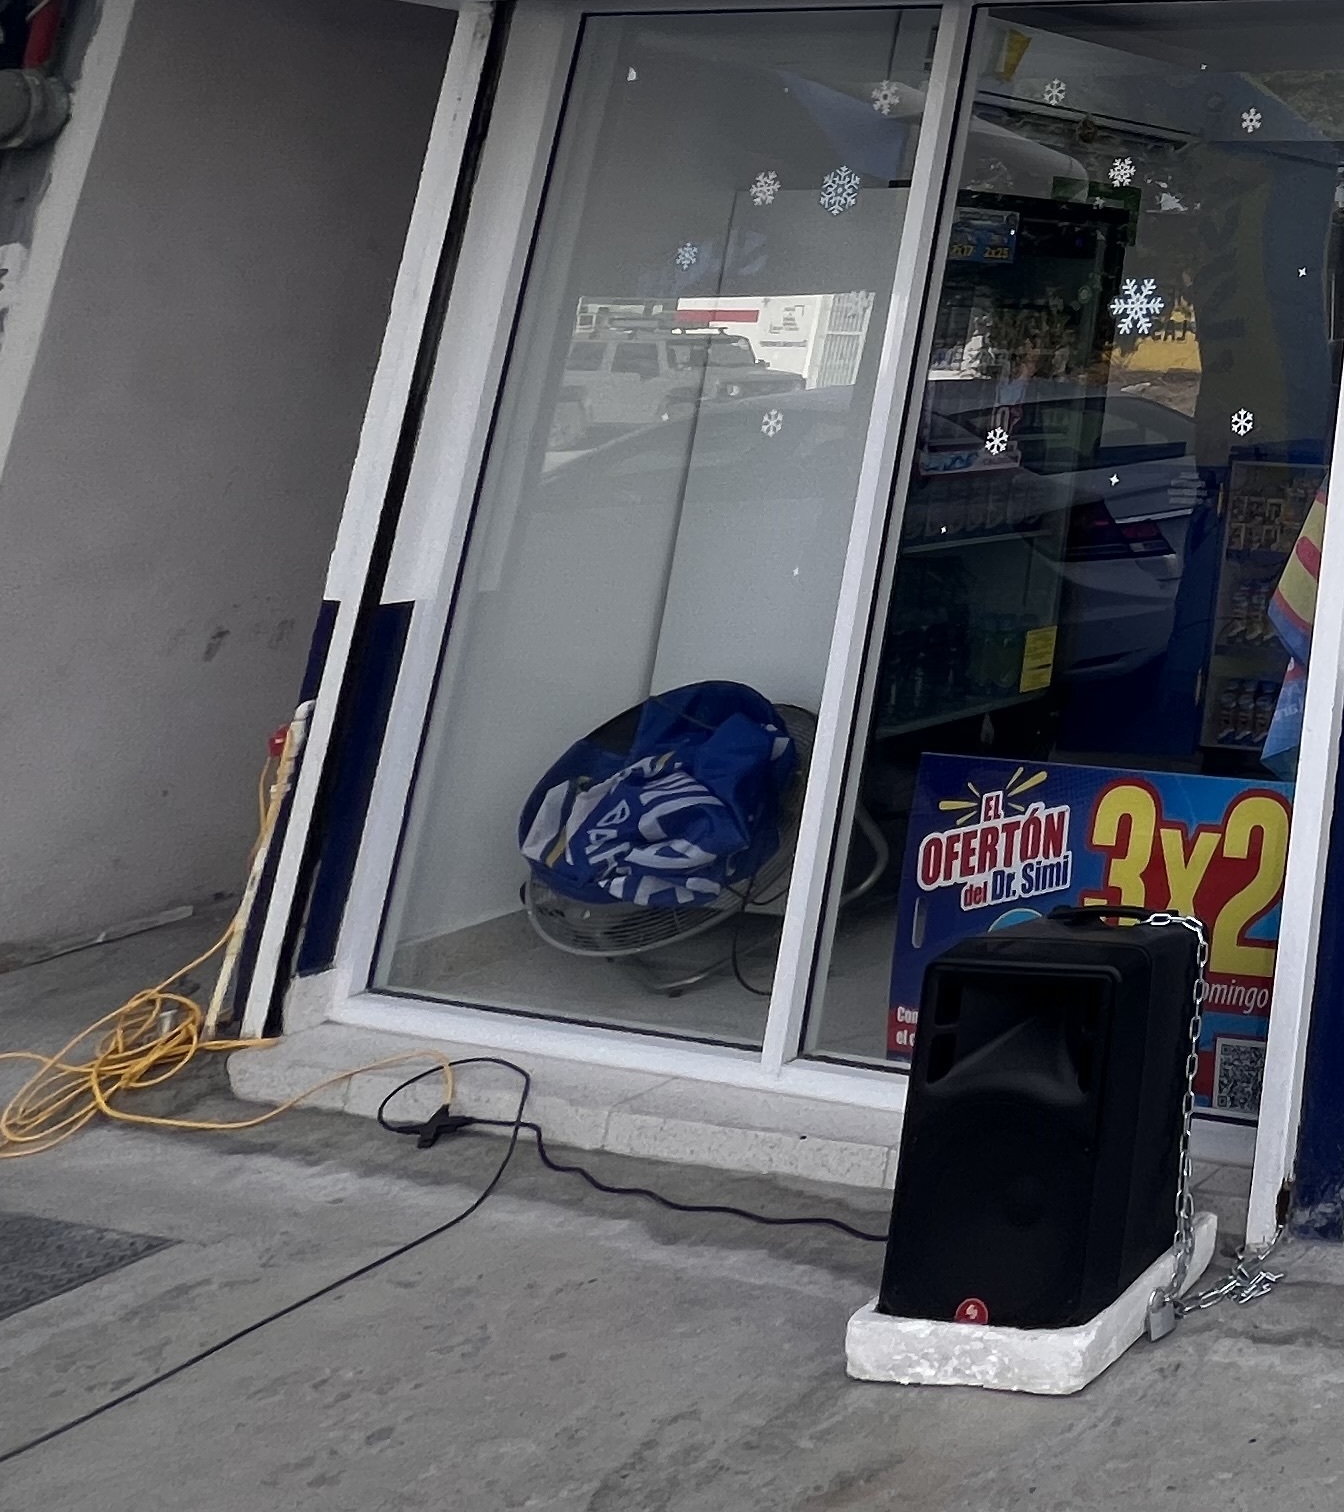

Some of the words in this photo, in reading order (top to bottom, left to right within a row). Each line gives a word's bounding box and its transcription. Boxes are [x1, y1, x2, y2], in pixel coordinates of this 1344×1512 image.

[983, 794, 1002, 822] EL
[921, 807, 1066, 885] OFERTÓN
[963, 881, 988, 907] del
[991, 870, 1017, 901] Dr.
[1021, 855, 1070, 893] Simi
